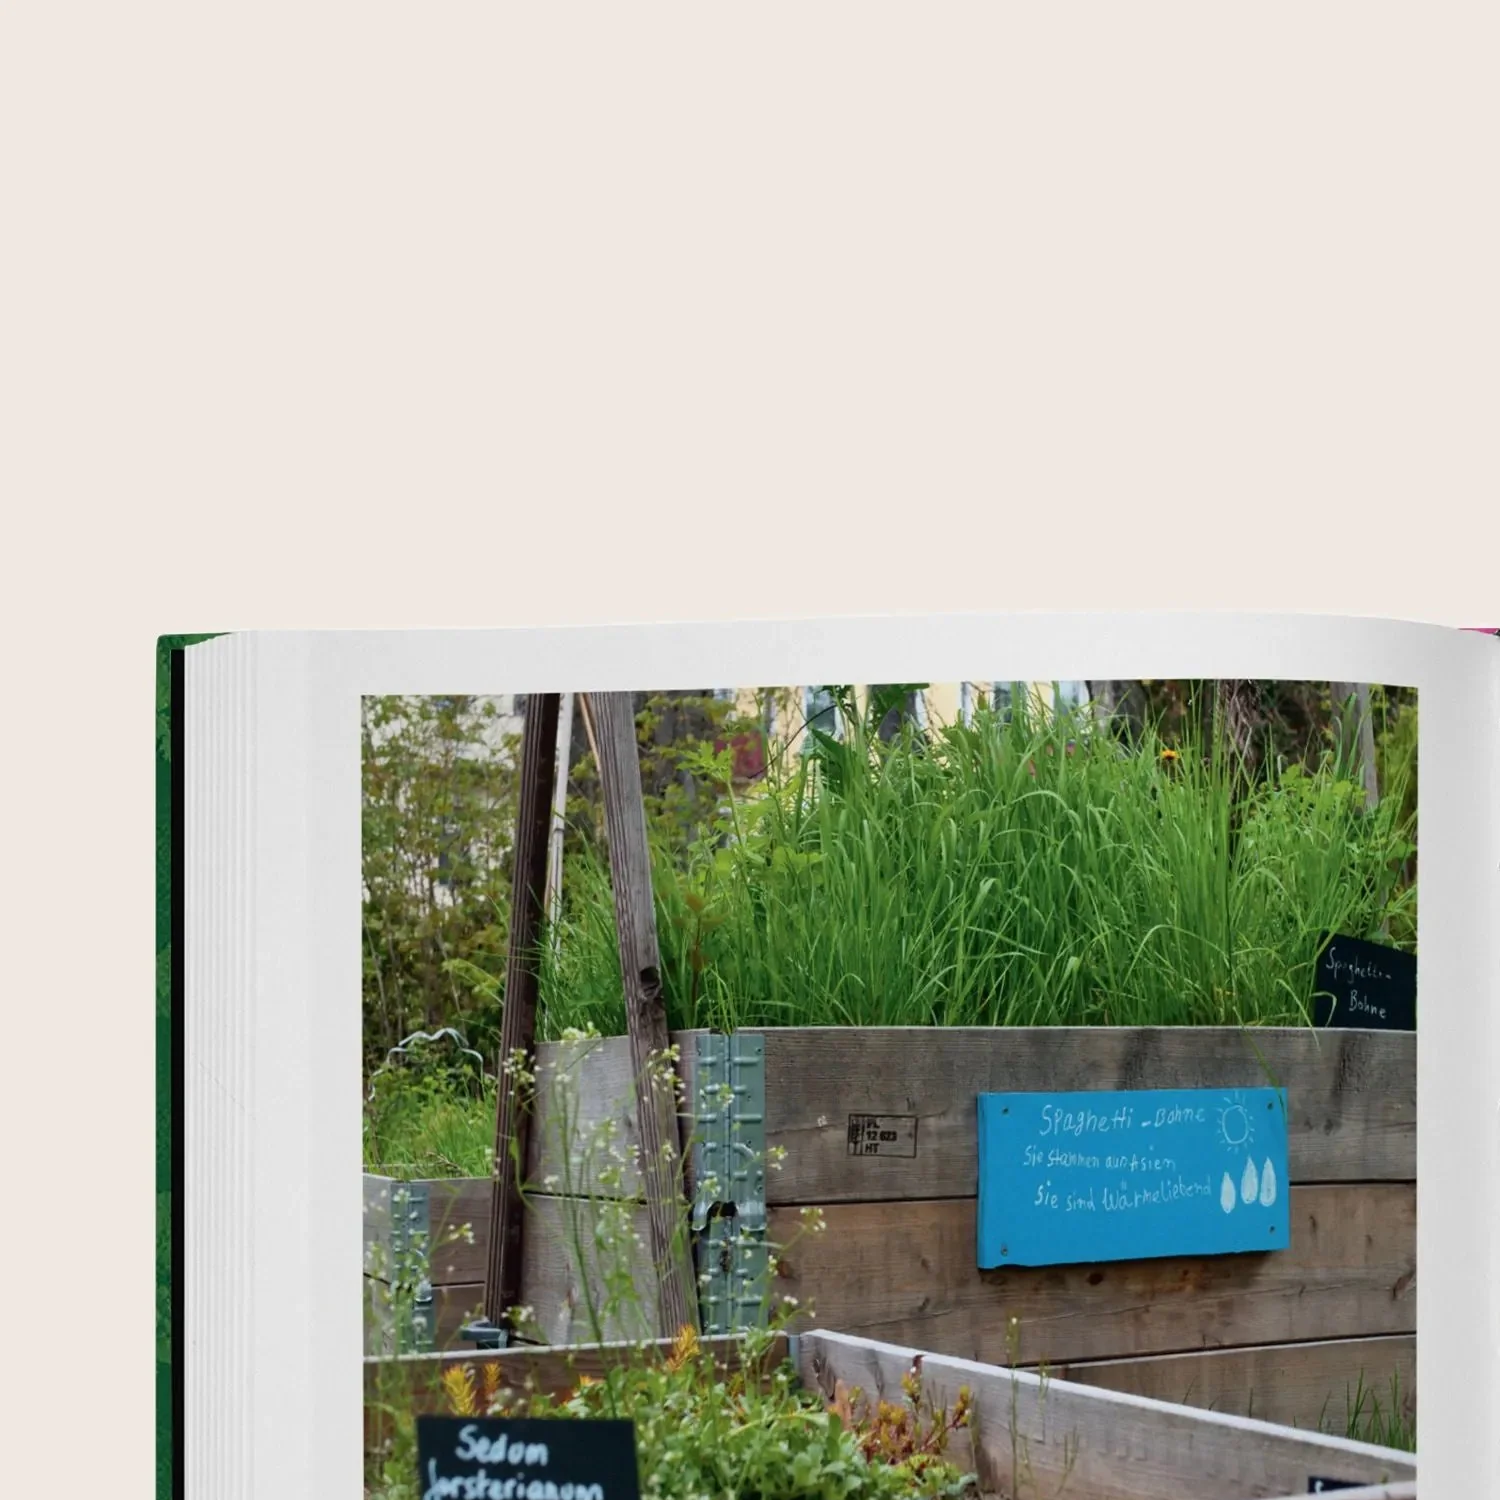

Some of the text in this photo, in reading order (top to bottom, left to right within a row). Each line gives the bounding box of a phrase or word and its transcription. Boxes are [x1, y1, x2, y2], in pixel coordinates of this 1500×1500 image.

[1349, 989, 1386, 1018] Bohne
[865, 1143, 880, 1153] HT
[1034, 1180, 1058, 1209] Sie
[1066, 1187, 1096, 1211] sind
